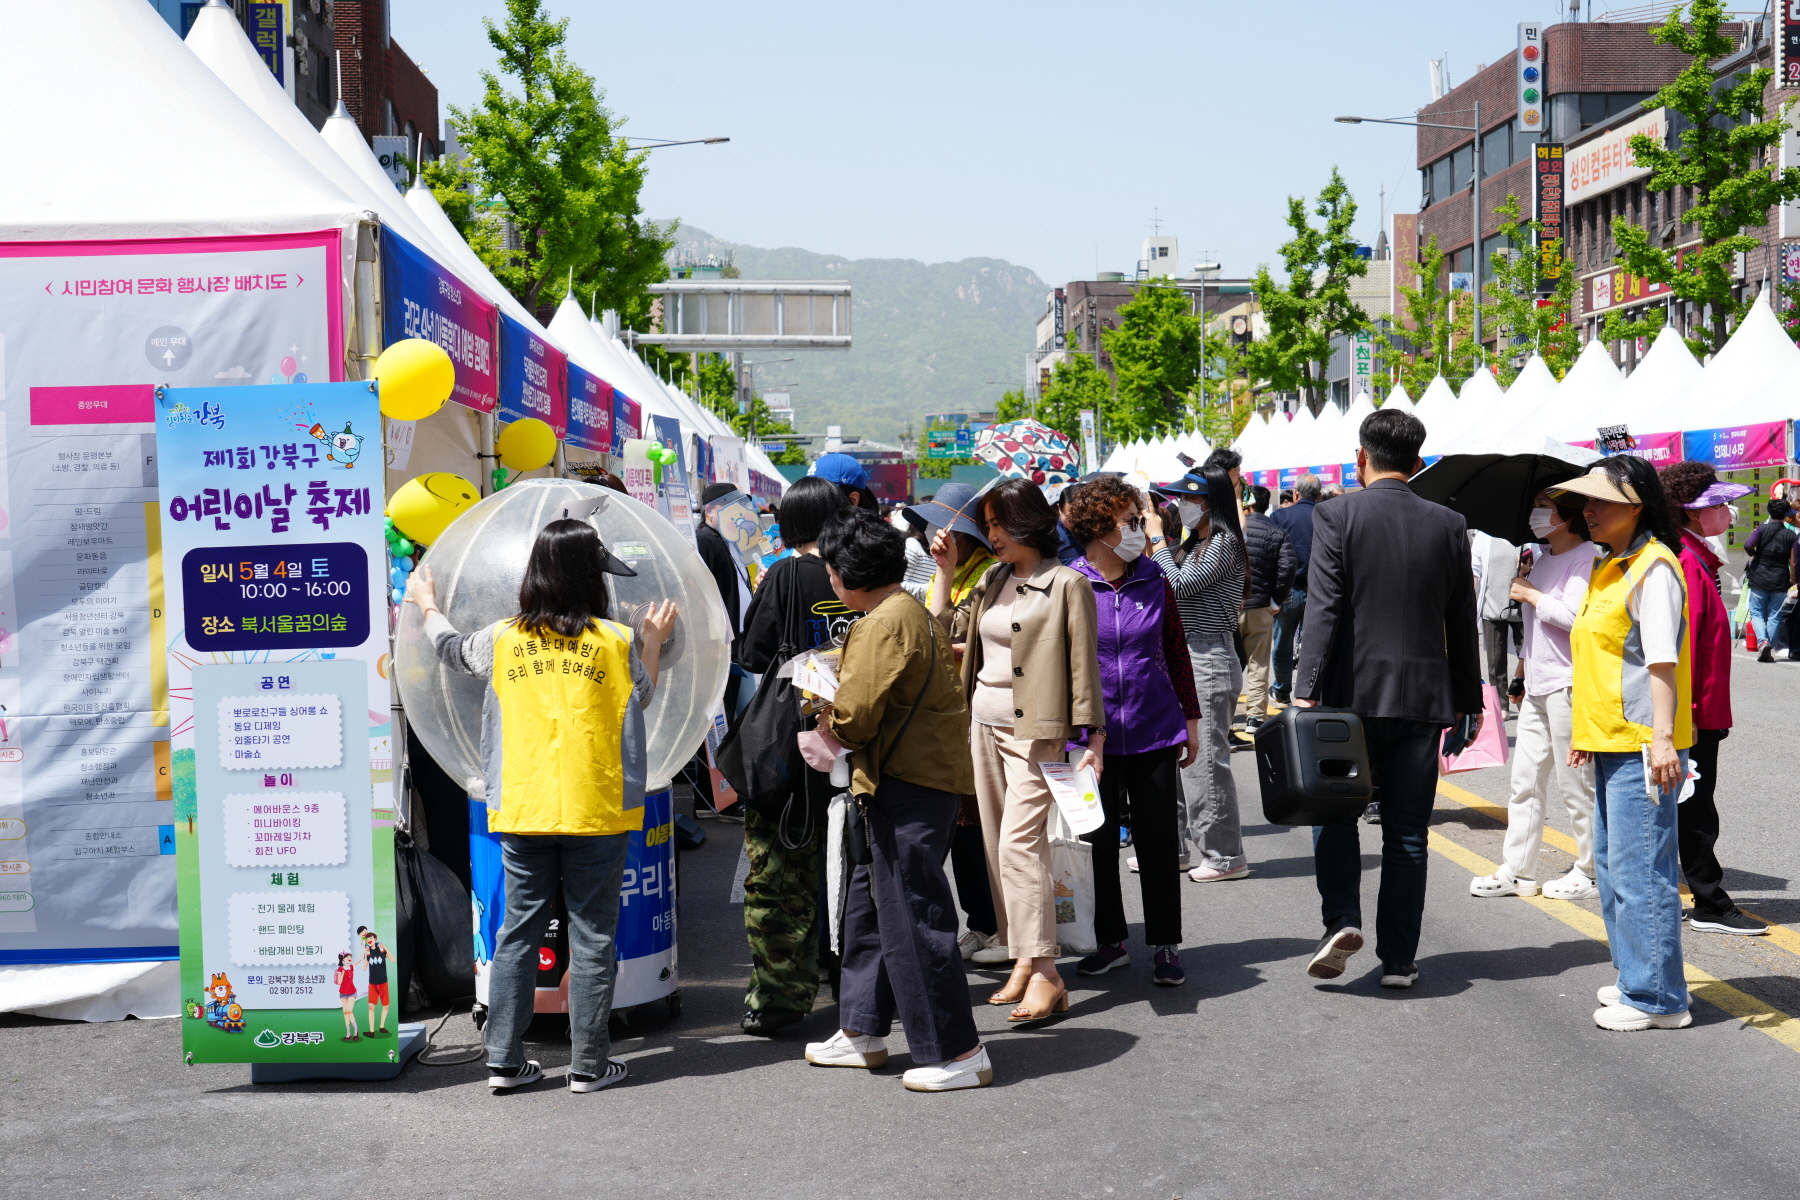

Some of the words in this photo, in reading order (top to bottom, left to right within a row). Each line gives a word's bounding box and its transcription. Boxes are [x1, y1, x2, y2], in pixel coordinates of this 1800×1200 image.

[1524, 28, 1537, 41] 민
[1528, 113, 1536, 121] 2F
[1537, 146, 1563, 160] 허브
[61, 278, 134, 297] 시민참여
[137, 277, 173, 296] 문화
[176, 275, 230, 295] 행사장
[234, 272, 288, 292] 배치도
[150, 336, 168, 347] 메인
[434, 313, 461, 362] 아동학대
[462, 328, 474, 369] 예방
[474, 334, 490, 376] 캠페인
[77, 400, 108, 410] 중앙무대
[193, 401, 225, 430] 강북
[1606, 438, 1628, 454] 사랑해
[58, 451, 81, 460] 행사장
[82, 450, 113, 460] 운영본부
[203, 446, 256, 470] 제1회
[260, 443, 320, 470] 강북구
[92, 462, 108, 471] 의료
[110, 462, 120, 471] 등)
[146, 456, 153, 466] F
[169, 482, 298, 534] 어린이날
[306, 480, 371, 531] 축제
[70, 522, 108, 532] 참새방앗간
[67, 536, 114, 546] 레인보우아트
[78, 566, 108, 576] 라미타로
[200, 563, 234, 583] 일시
[240, 562, 269, 580] 5월
[273, 560, 302, 578] 4일
[310, 558, 330, 578] 토
[240, 582, 287, 599] 10:00
[304, 581, 351, 596] 16:00
[71, 597, 94, 606] 모두의
[96, 596, 117, 605] 이야기
[64, 611, 106, 622] 서울청년센터
[108, 610, 125, 620] 강북
[154, 608, 162, 618] D
[201, 616, 236, 636] 장소
[241, 612, 348, 634] 북서울꿈의숲
[62, 627, 78, 637] 강북
[78, 626, 93, 636] 열린
[95, 626, 110, 636] 미술
[112, 626, 127, 635] 놀이
[60, 642, 98, 652] 청소년들을
[98, 642, 114, 651] 위한
[115, 641, 131, 650] 모임
[514, 638, 600, 660] 아동학대예방!
[72, 657, 94, 666] 강북구
[508, 664, 528, 683] 우리
[533, 658, 554, 675] 함께
[562, 659, 606, 684] 참여해요
[233, 706, 288, 718] 뽀로로친구들
[289, 706, 316, 717] 싱어롱
[318, 706, 328, 716] 쇼
[234, 721, 252, 732] 동요
[254, 720, 281, 731] 디제잉
[234, 734, 270, 746] 외줄타기
[272, 734, 290, 744] 공연
[234, 749, 262, 760] 마술쇼
[159, 766, 167, 776] C
[80, 776, 118, 786] 재난안전과
[85, 792, 116, 800] 청소년과
[253, 804, 300, 815] 에어바운스
[304, 803, 320, 814] 9종
[254, 818, 301, 828] 미니바이킹
[84, 830, 122, 840] 종합안내소
[163, 834, 172, 844] A
[254, 831, 312, 842] 꼬마레일기차
[105, 845, 136, 856] 체험부스
[254, 846, 274, 856] 회전
[276, 846, 297, 856] UFO
[0, 864, 22, 872] 전시존
[270, 872, 300, 887] 체험
[620, 862, 662, 907] 우리
[257, 904, 276, 914] 전기
[277, 904, 295, 914] 물레
[296, 902, 315, 914] 체험
[258, 924, 276, 935] 핸드
[278, 924, 305, 935] 페인팅
[258, 945, 294, 956] 바람개비
[296, 944, 323, 956] 만들기
[296, 974, 326, 985] 청소년과
[269, 986, 278, 996] 02
[280, 986, 292, 996] 901
[294, 986, 313, 995] 2512
[282, 1032, 324, 1045] 강북구
